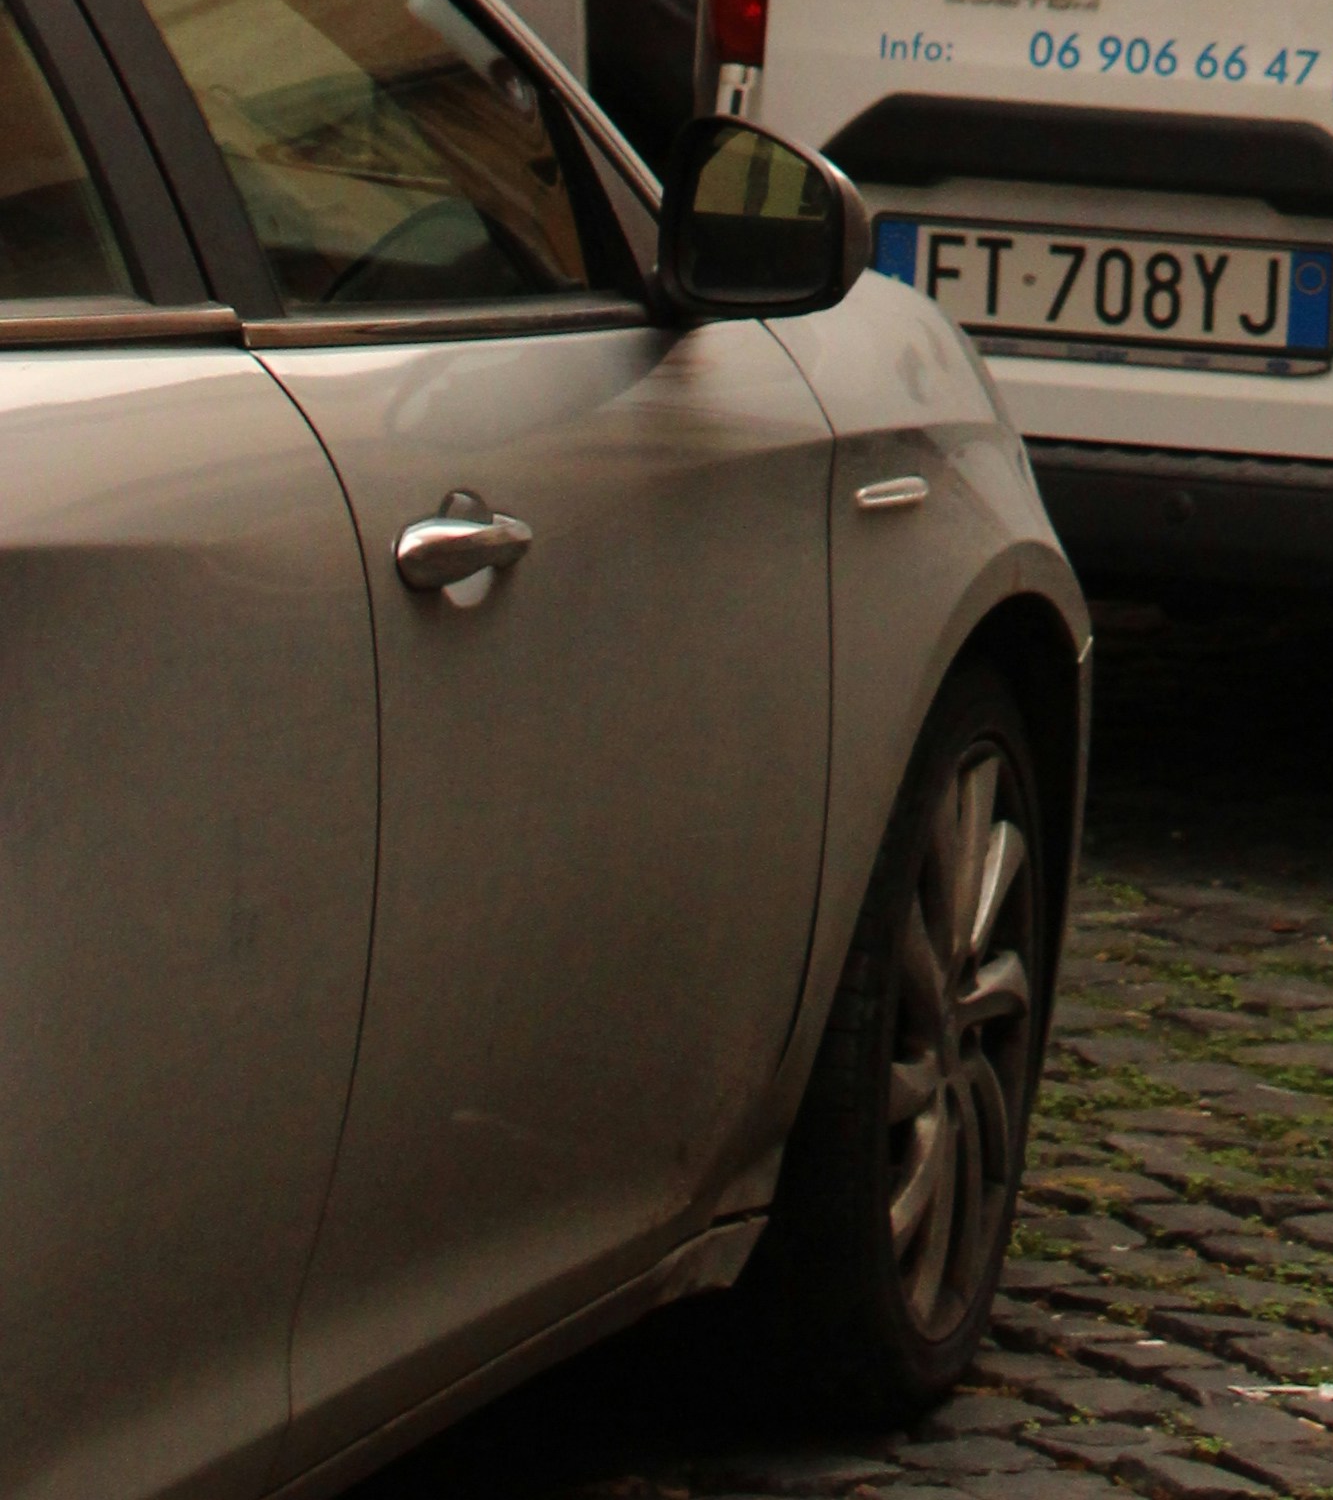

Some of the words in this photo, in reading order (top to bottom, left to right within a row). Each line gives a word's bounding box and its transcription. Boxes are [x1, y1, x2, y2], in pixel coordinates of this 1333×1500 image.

[879, 32, 954, 62] Info:
[1028, 30, 1081, 69] 06
[1098, 35, 1178, 77] 906
[1195, 42, 1248, 81] 66
[1264, 47, 1321, 87] 47
[927, 233, 1014, 316] FT
[1045, 243, 1280, 336] 708YJ
